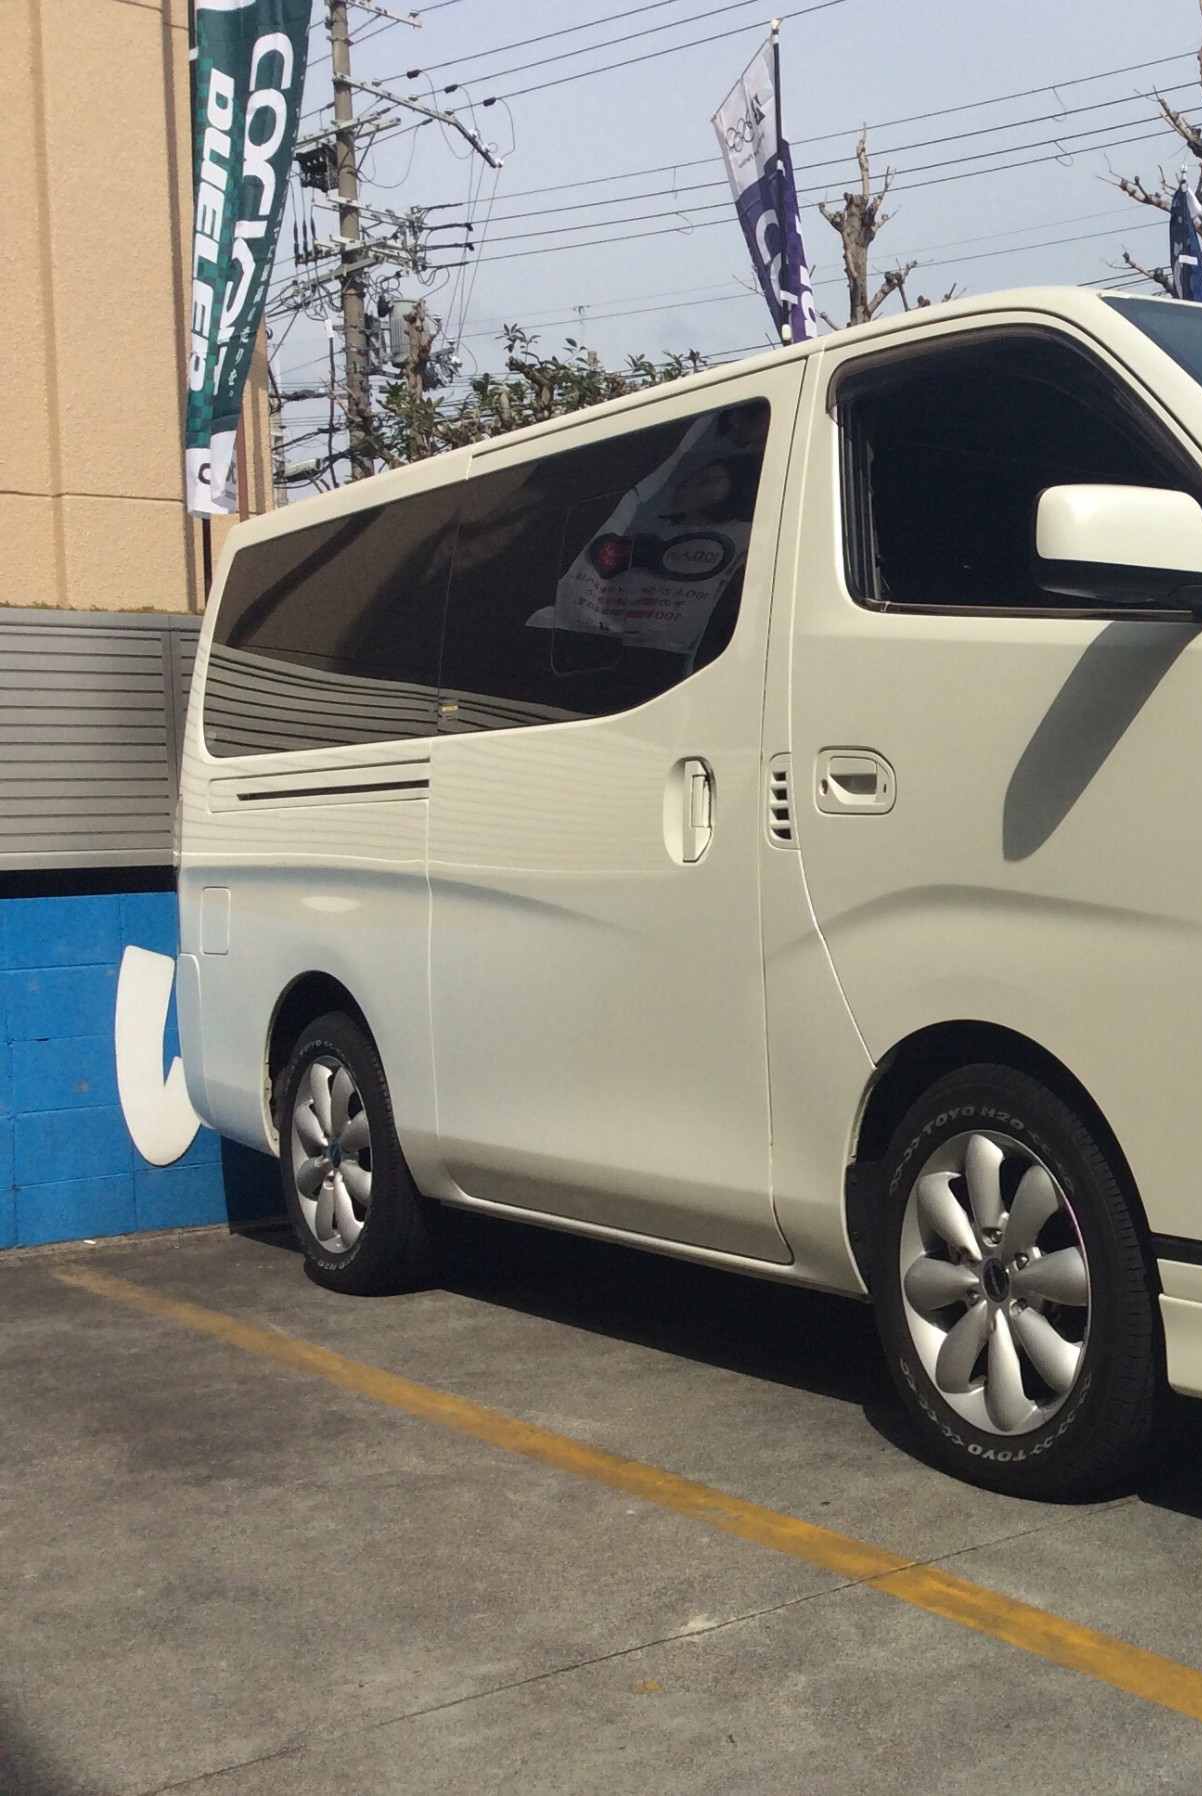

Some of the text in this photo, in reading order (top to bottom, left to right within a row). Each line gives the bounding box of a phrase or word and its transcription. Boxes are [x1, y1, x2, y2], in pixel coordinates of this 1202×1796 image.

[189, 67, 235, 392] DUELER
[922, 1105, 976, 1136] TOYO
[967, 1443, 1027, 1462] TOYO
